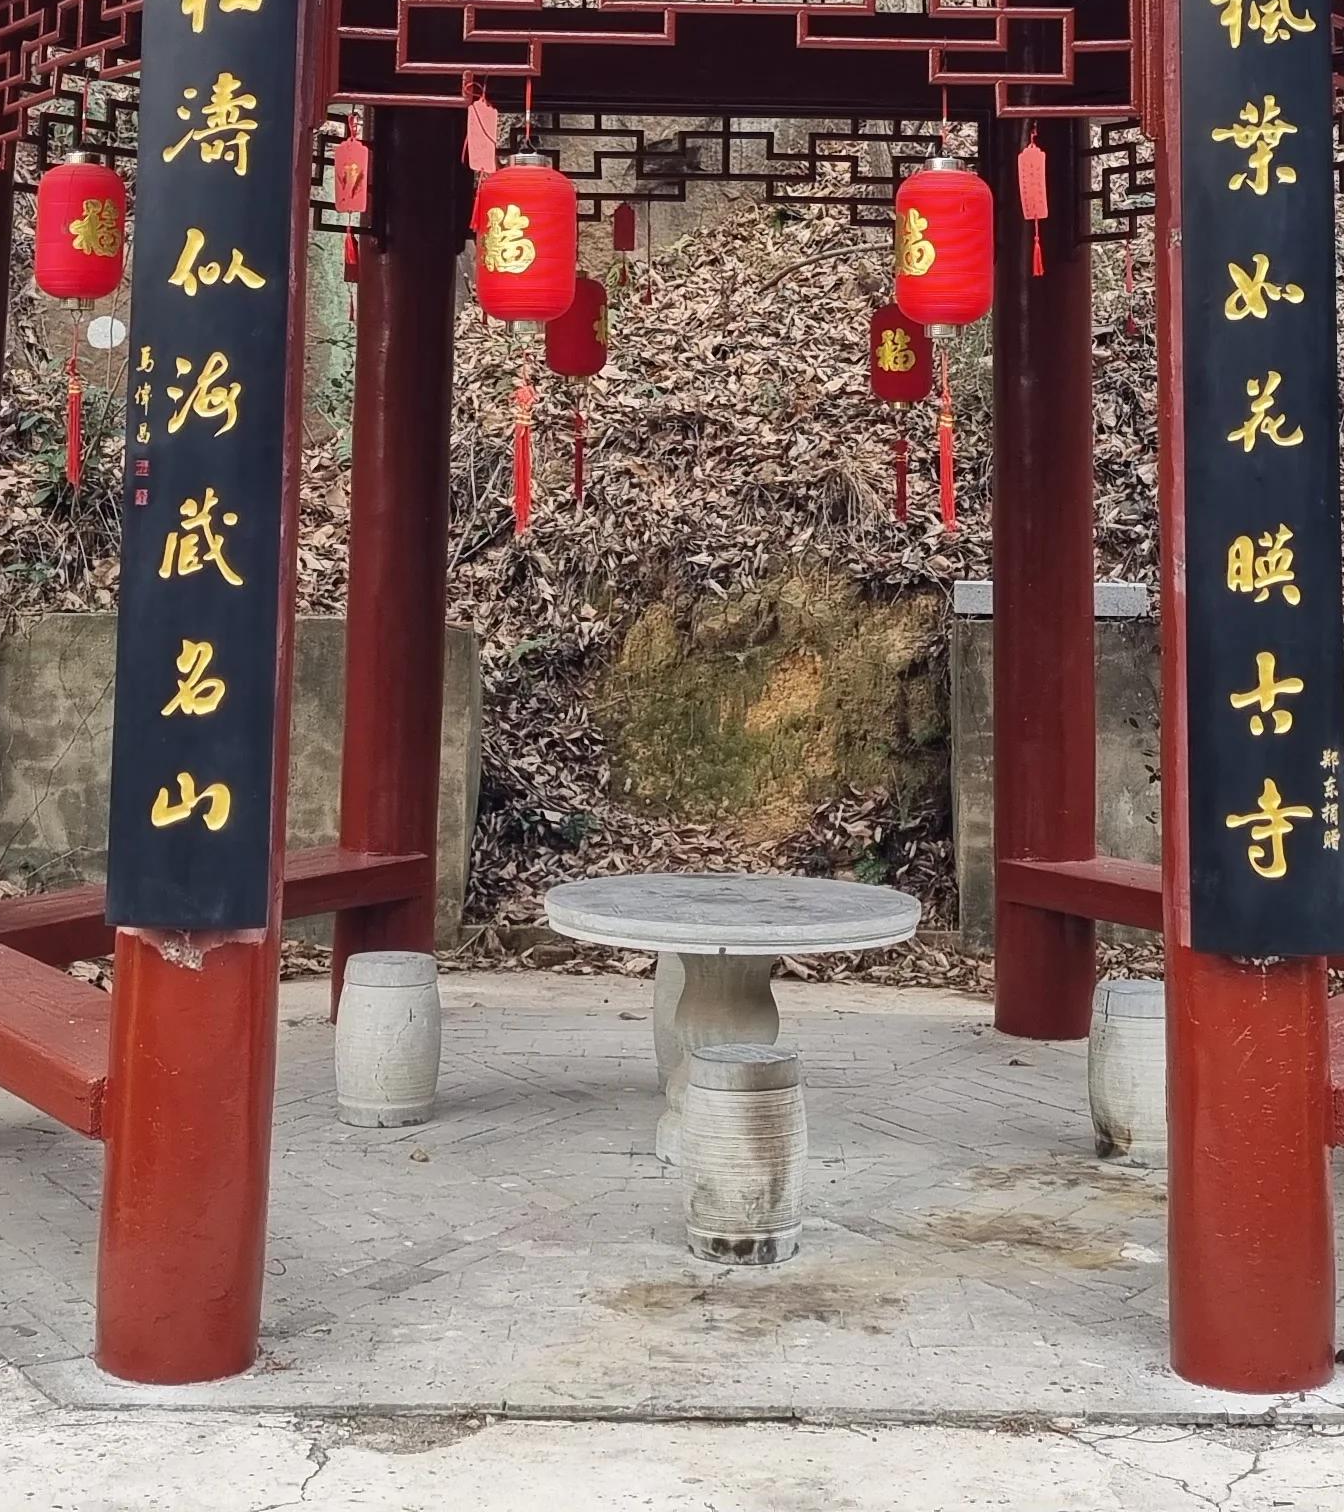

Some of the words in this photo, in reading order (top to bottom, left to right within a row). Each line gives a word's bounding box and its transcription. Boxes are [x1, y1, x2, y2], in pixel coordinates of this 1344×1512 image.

[69, 199, 120, 257] 福
[482, 204, 536, 274] 福
[875, 328, 915, 372] 福
